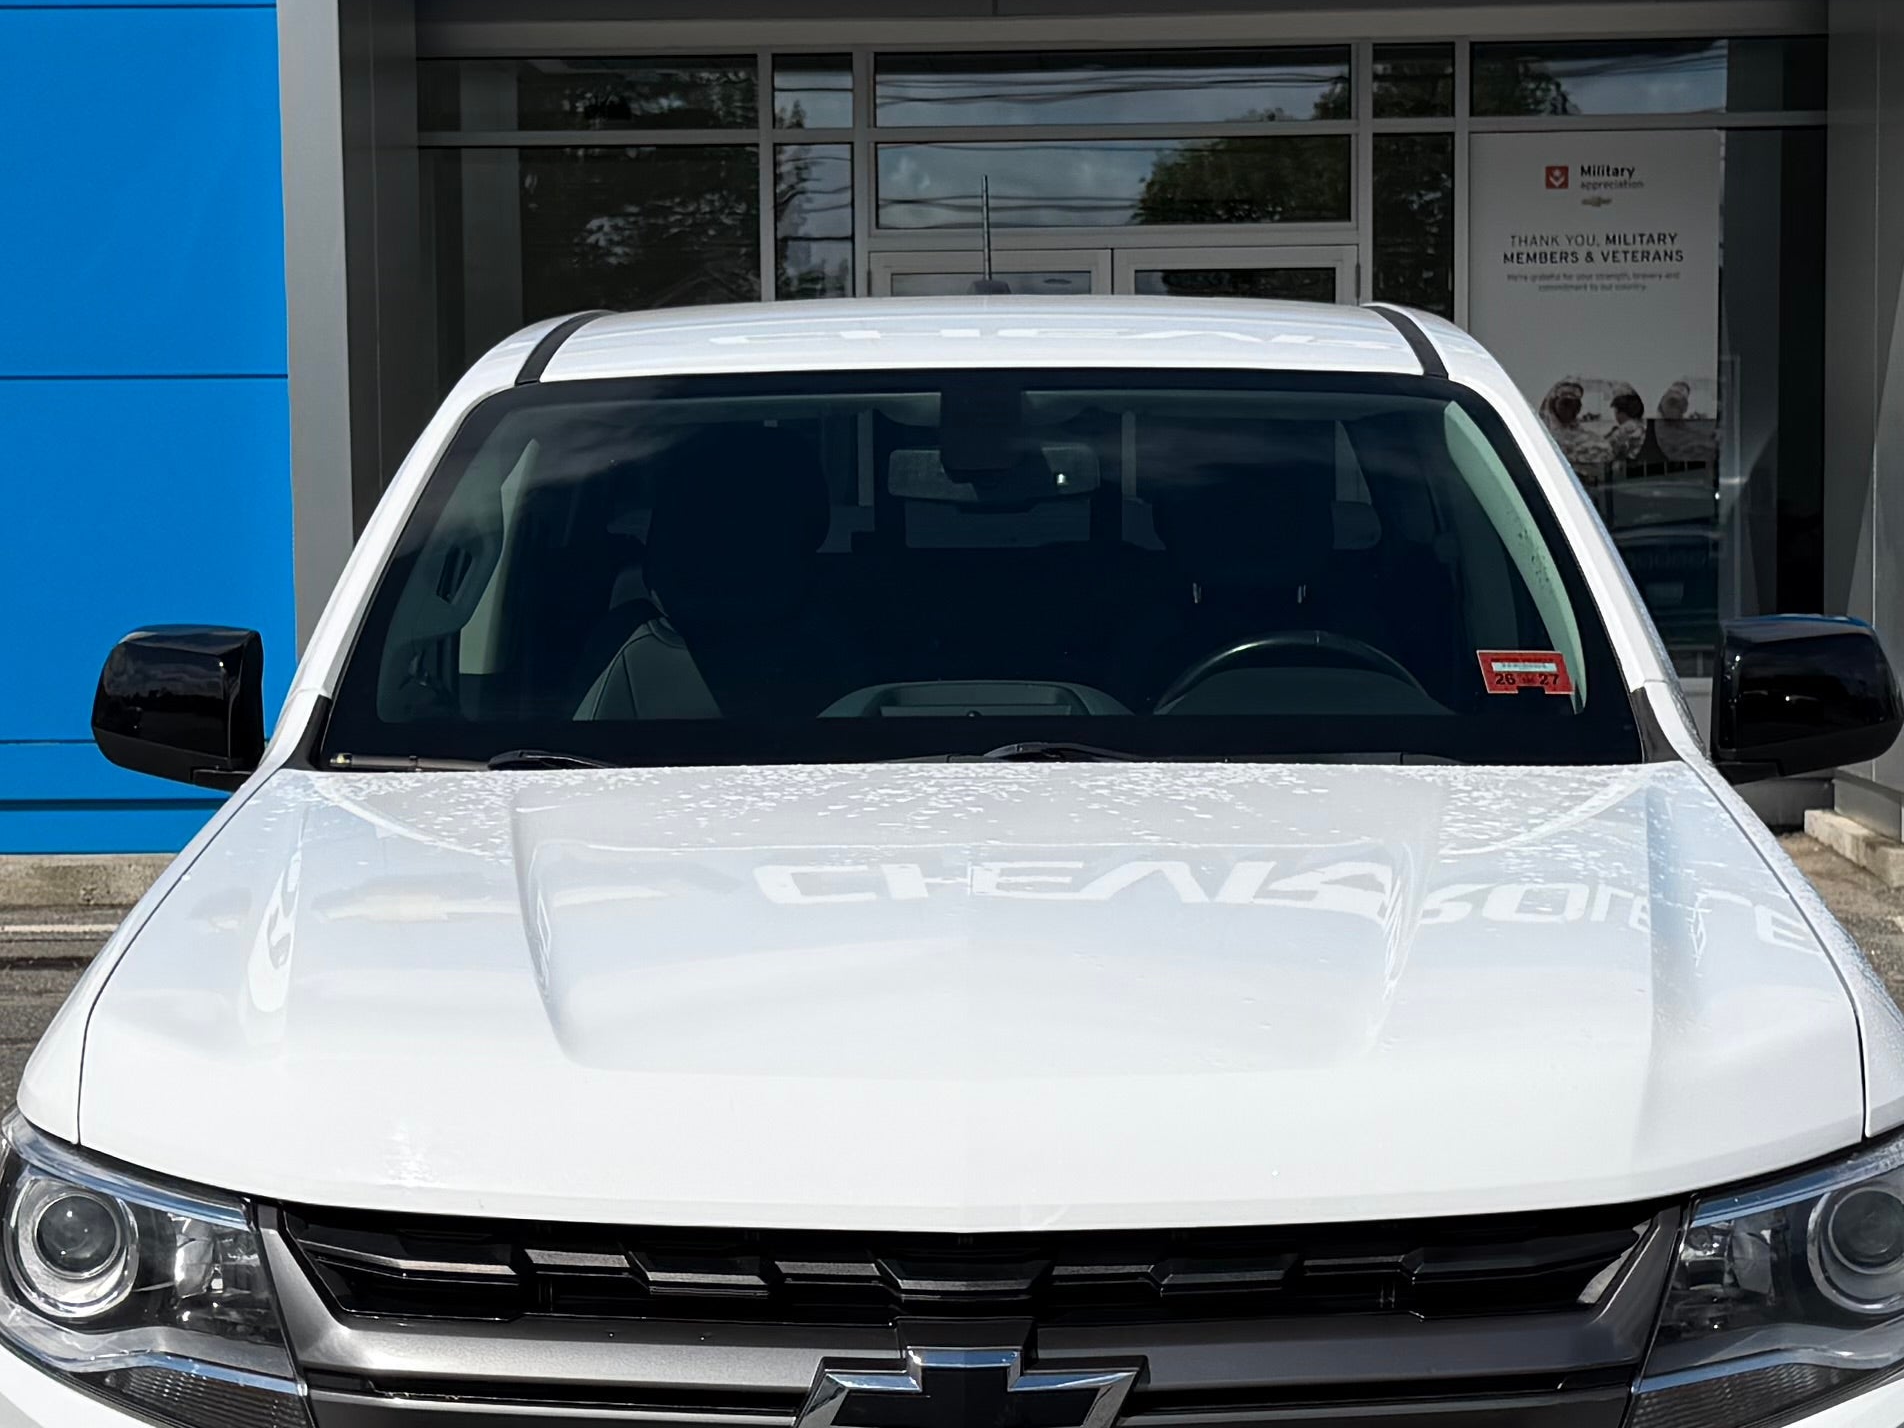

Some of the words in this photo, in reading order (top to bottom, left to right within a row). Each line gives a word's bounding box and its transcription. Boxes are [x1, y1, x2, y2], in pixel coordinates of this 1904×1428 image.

[1580, 164, 1636, 179] Military
[1510, 234, 1560, 248] THANK
[1605, 232, 1678, 247] MILITARY
[1503, 251, 1580, 265] MEMBERS
[1584, 251, 1595, 264] &
[1600, 249, 1685, 264] VETERANS
